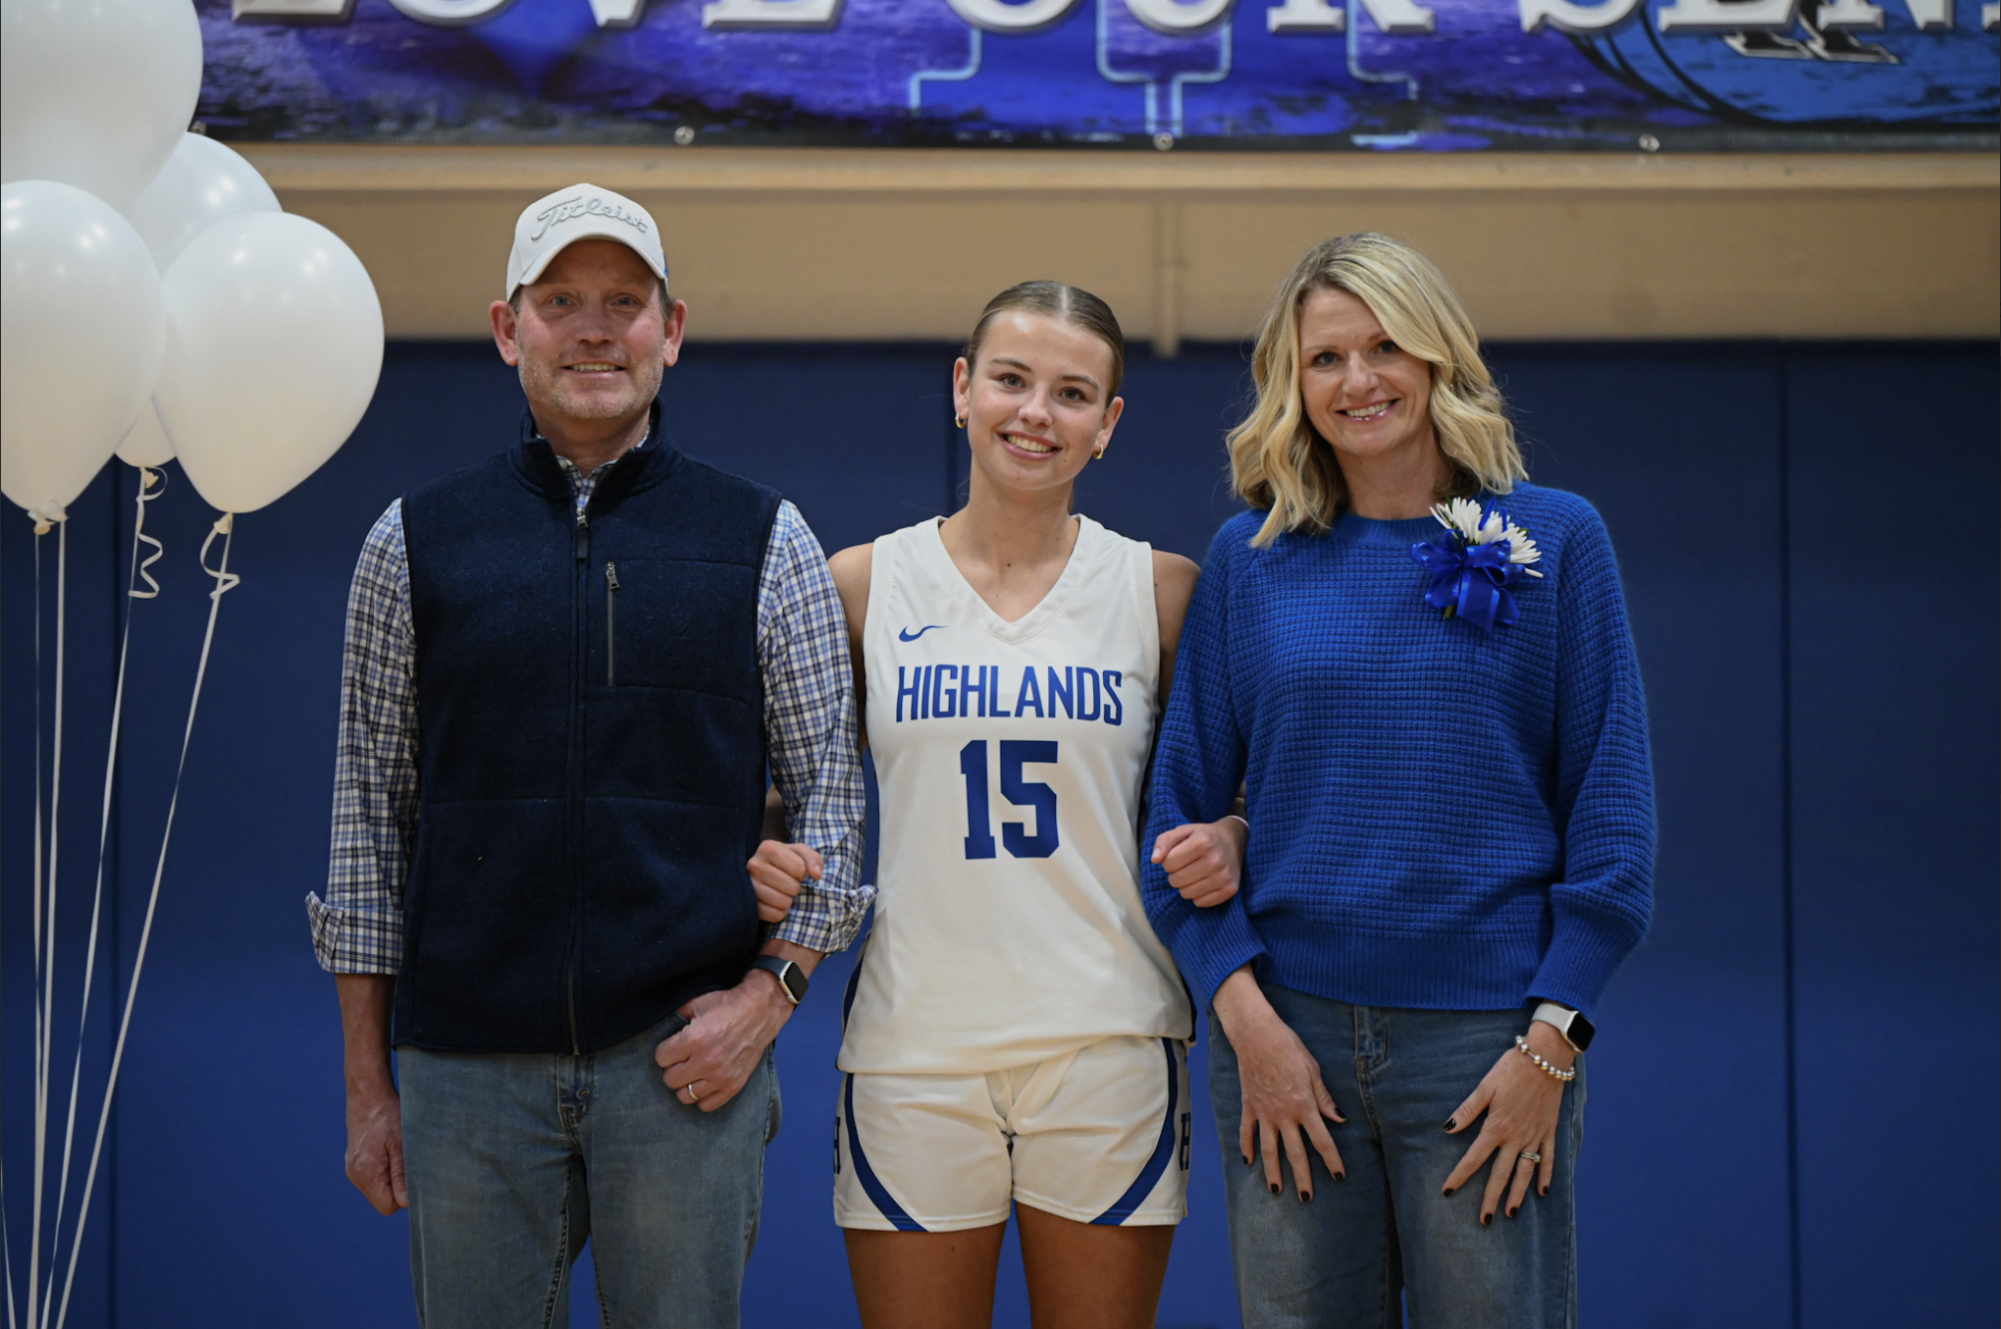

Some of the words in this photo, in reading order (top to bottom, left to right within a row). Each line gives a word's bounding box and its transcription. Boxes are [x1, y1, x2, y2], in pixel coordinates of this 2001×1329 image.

[531, 196, 648, 241] Titleist
[896, 664, 1123, 726] HIGHLANDS
[960, 739, 1060, 860] 15
